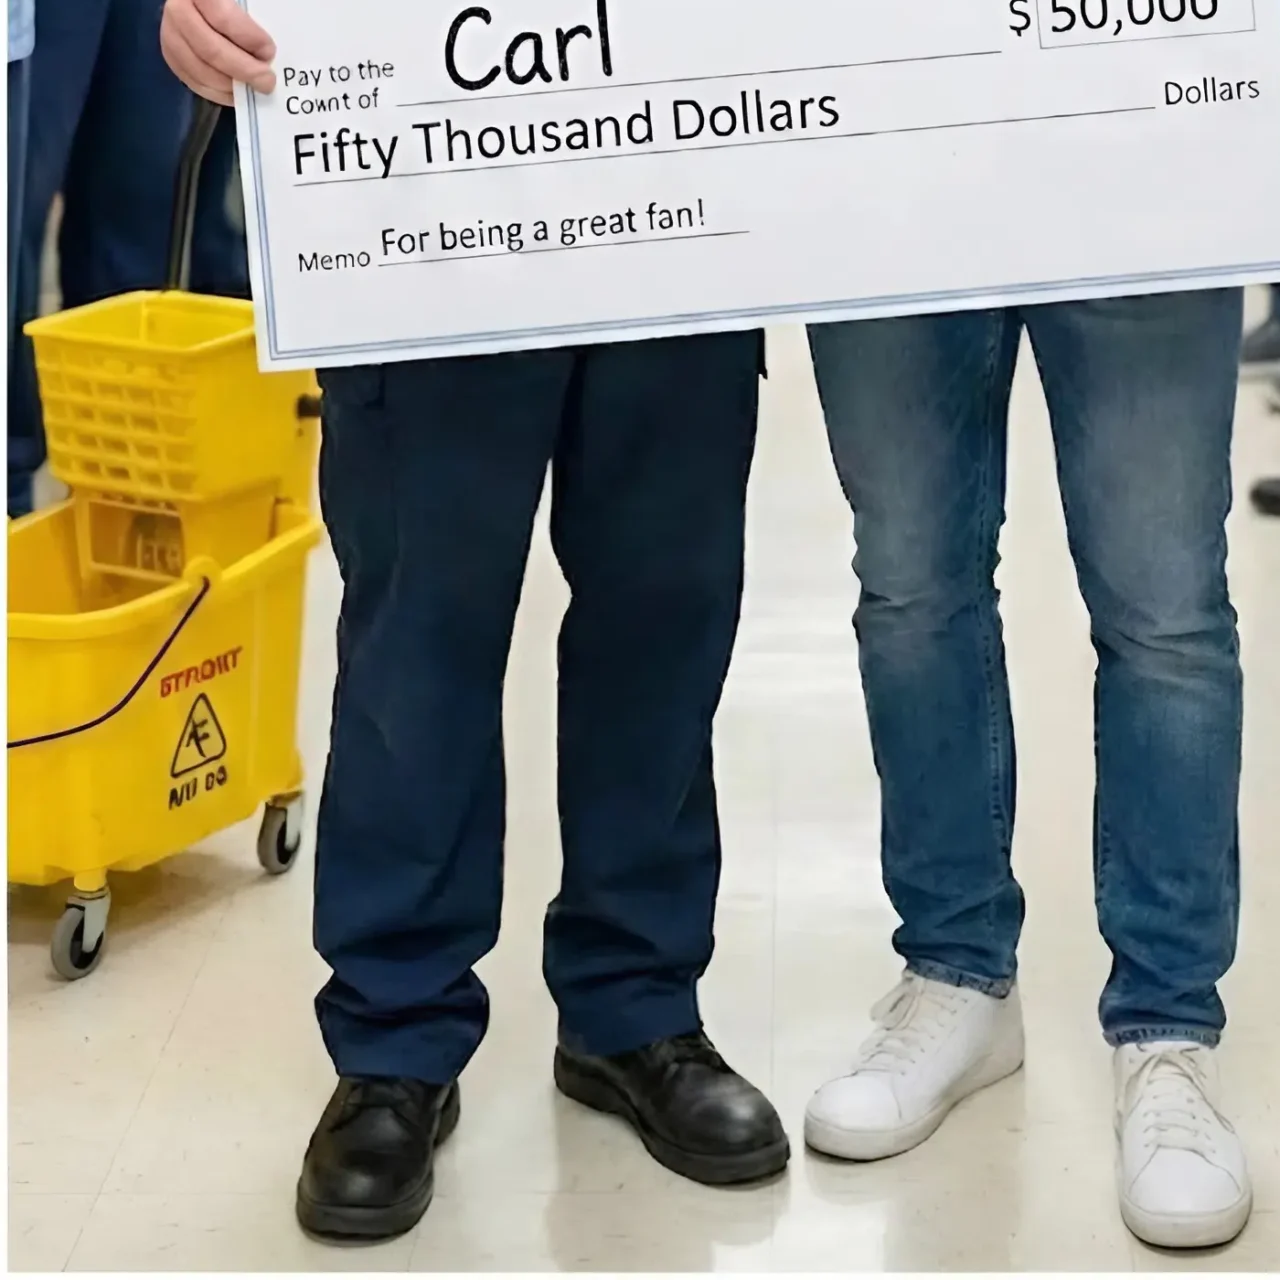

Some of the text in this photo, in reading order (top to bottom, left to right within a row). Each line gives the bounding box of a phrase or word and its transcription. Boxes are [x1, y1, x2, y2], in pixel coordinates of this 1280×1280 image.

[284, 59, 395, 87] Pay to the
[358, 87, 380, 110] of
[1164, 76, 1260, 106] Dollars
[293, 89, 840, 179] Fifty Thousand Dollars
[381, 198, 705, 256] For being a great fan!
[298, 250, 371, 273] Memo
